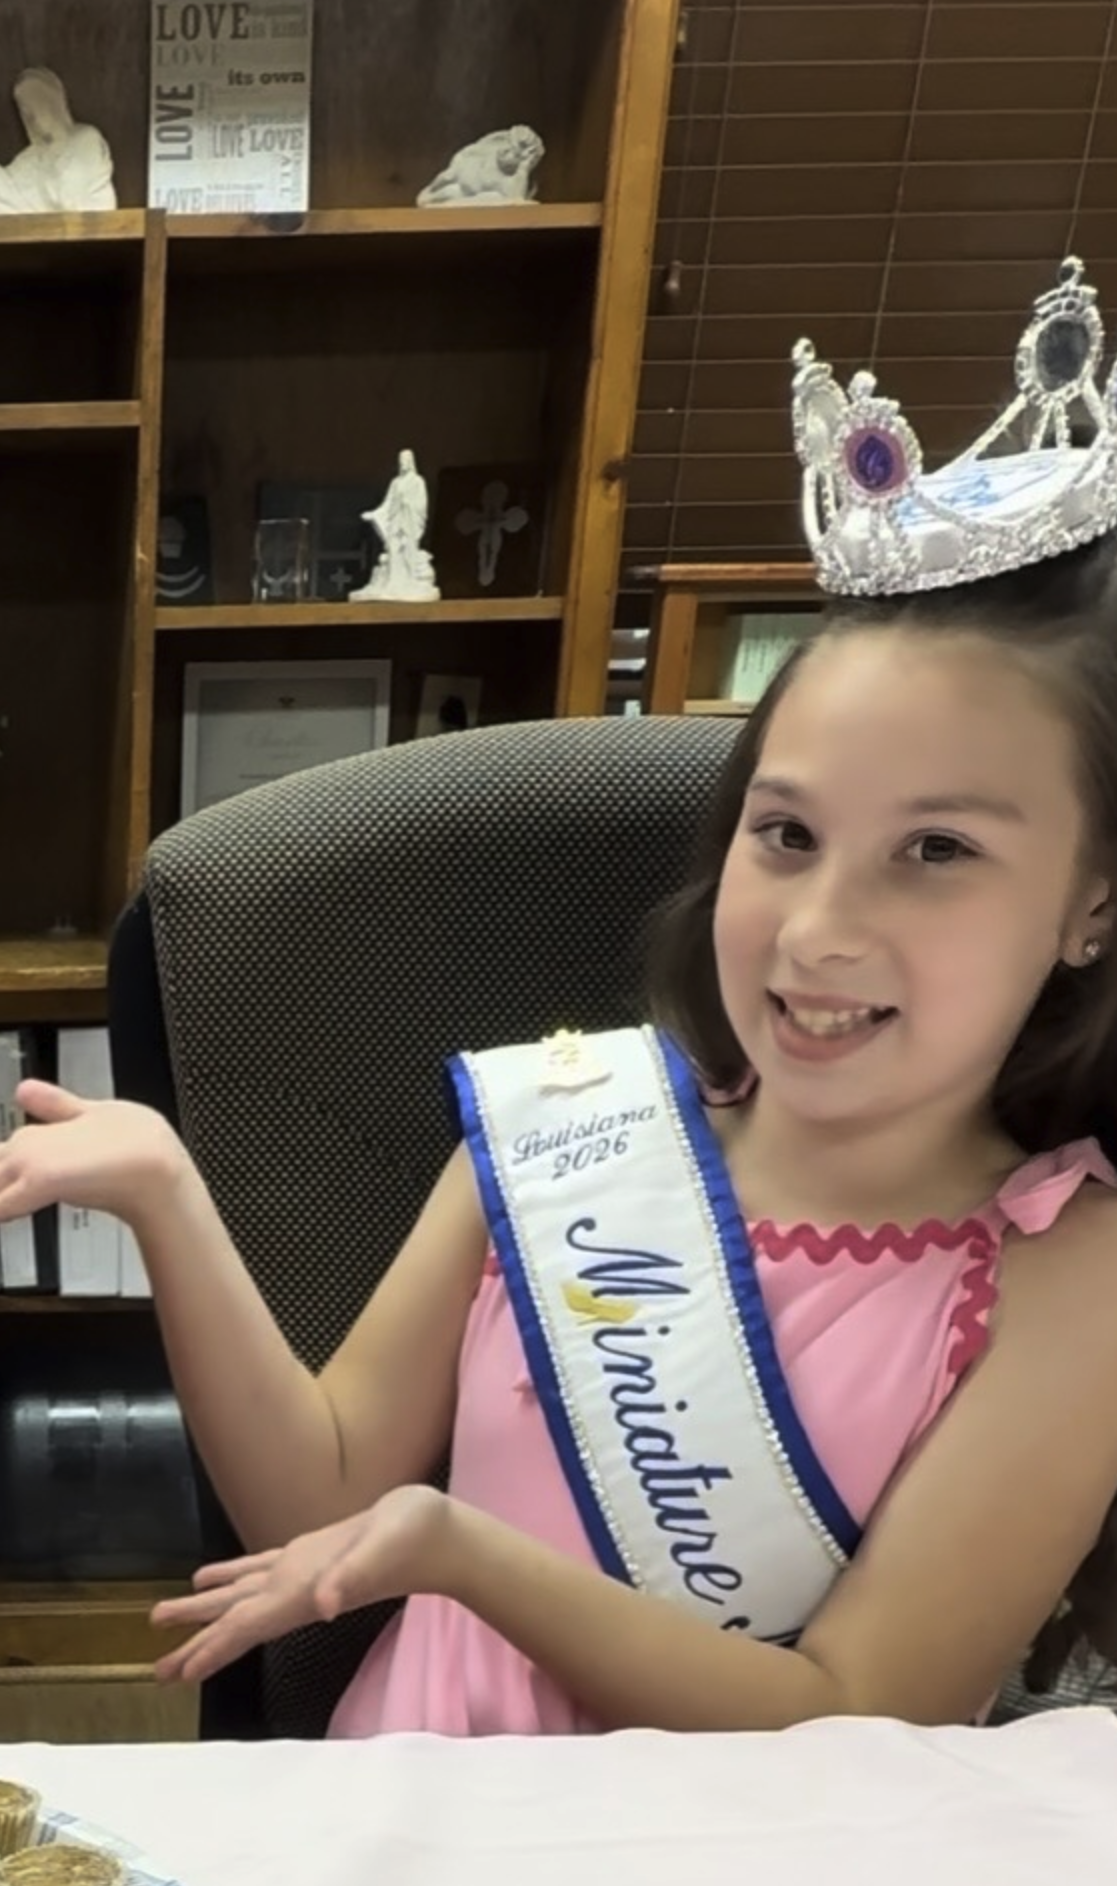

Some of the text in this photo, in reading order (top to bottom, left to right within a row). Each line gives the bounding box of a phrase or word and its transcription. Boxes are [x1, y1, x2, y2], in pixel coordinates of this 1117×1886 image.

[156, 3, 249, 41] LOVE
[156, 44, 224, 66] LOVE
[228, 69, 306, 86] its own
[155, 84, 194, 161] LOVE
[250, 128, 304, 152] LOVE
[511, 1104, 657, 1166] Louisiana
[552, 1131, 631, 1181] 2026
[566, 1217, 743, 1606] Miniature
